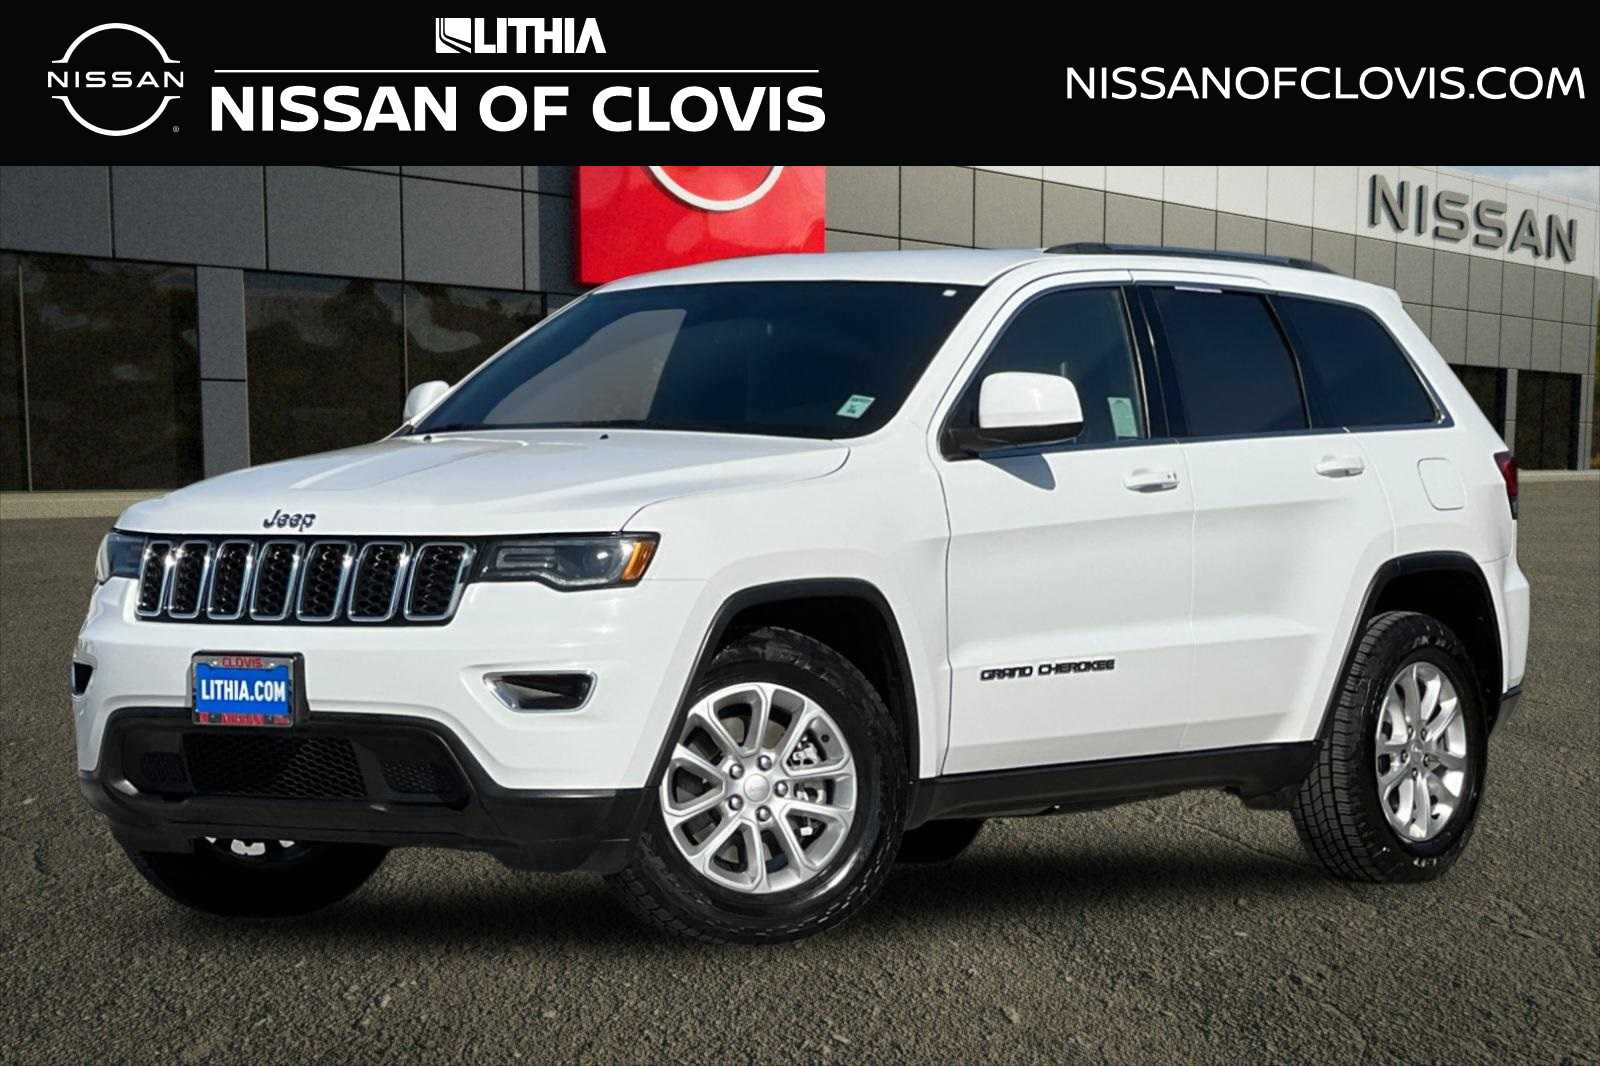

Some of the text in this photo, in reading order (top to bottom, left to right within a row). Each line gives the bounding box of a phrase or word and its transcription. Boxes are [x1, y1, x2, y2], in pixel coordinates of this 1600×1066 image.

[1369, 174, 1577, 263] NISSAN
[263, 509, 316, 532] Jeep
[980, 659, 1115, 681] GRAND CHEROKEE
[201, 679, 286, 702] LITHIA.COM
